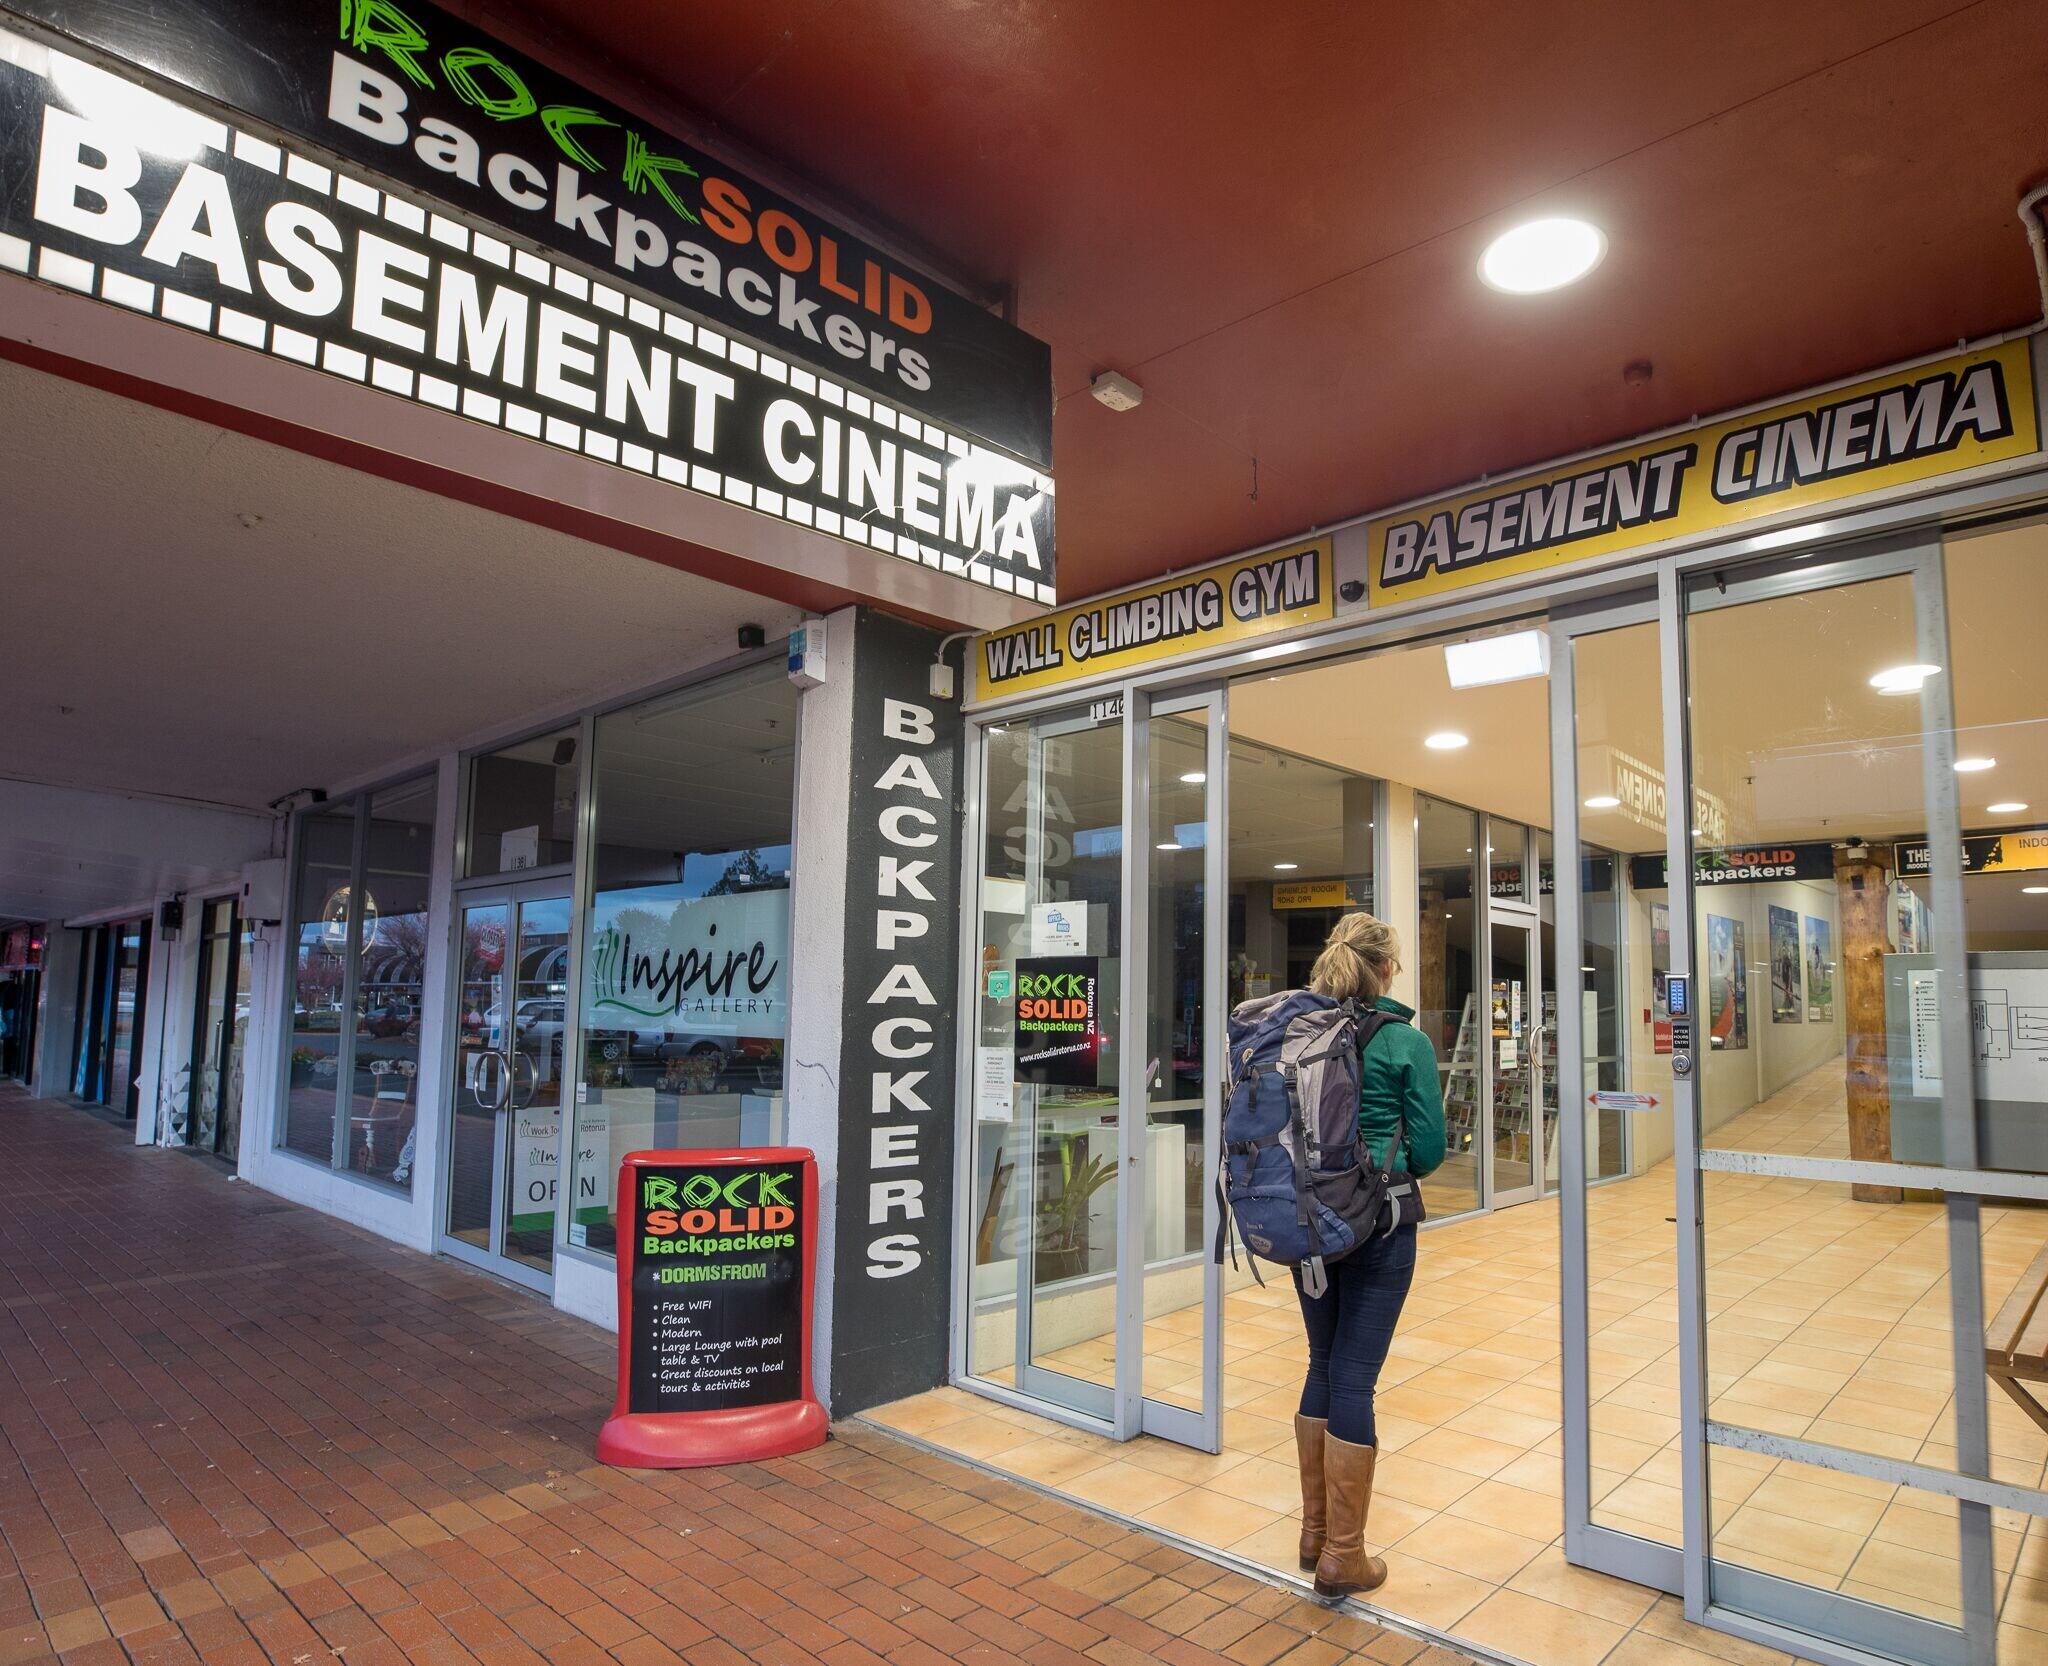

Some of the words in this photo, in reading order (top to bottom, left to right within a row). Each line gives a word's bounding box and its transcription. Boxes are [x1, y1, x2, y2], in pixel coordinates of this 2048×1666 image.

[340, 0, 700, 225] ROCK
[700, 177, 933, 335] SOLID
[328, 50, 932, 392] Backpackers
[34, 105, 735, 455] BASEMENT
[763, 399, 1042, 570] CINEMA
[1380, 443, 1699, 588] BASEMENT
[1711, 359, 2015, 504] CINEMA
[985, 623, 1064, 684] WALL
[1068, 578, 1224, 662] CLIMBING
[1229, 549, 1320, 622] GYM
[1729, 849, 1796, 866] SOLID
[1906, 848, 1931, 863] THE
[620, 923, 779, 1016] Inspire
[866, 697, 943, 1280] BACKPACKERS
[1018, 973, 1087, 998] ROCK
[679, 998, 773, 1014] GALLERY
[1087, 977, 1095, 1018] Rotorua
[1018, 999, 1088, 1019] SOLID
[1020, 1020, 1085, 1033] Backpackers
[1087, 1020, 1095, 1035] NZ
[531, 1127, 549, 1136] Work
[528, 1175, 595, 1202] OPN
[644, 1171, 795, 1211] ROCK
[644, 1206, 795, 1236] SOLID
[643, 1232, 795, 1256] Backpackers
[662, 1301, 685, 1312] Free
[688, 1300, 712, 1311] WIFI
[661, 1315, 691, 1325] Clean
[661, 1328, 703, 1339] Modern
[661, 1342, 691, 1354] Large
[694, 1341, 732, 1353] Lounge
[735, 1336, 759, 1349] with
[761, 1333, 783, 1349] pool
[660, 1354, 687, 1366] table
[690, 1355, 700, 1365] &
[703, 1353, 720, 1364] TV
[660, 1368, 691, 1380] Great
[694, 1366, 742, 1379] discounts
[745, 1365, 758, 1374] on
[761, 1360, 784, 1373] local
[660, 1382, 688, 1394] tours
[691, 1382, 701, 1393] &
[704, 1378, 751, 1392] activities
